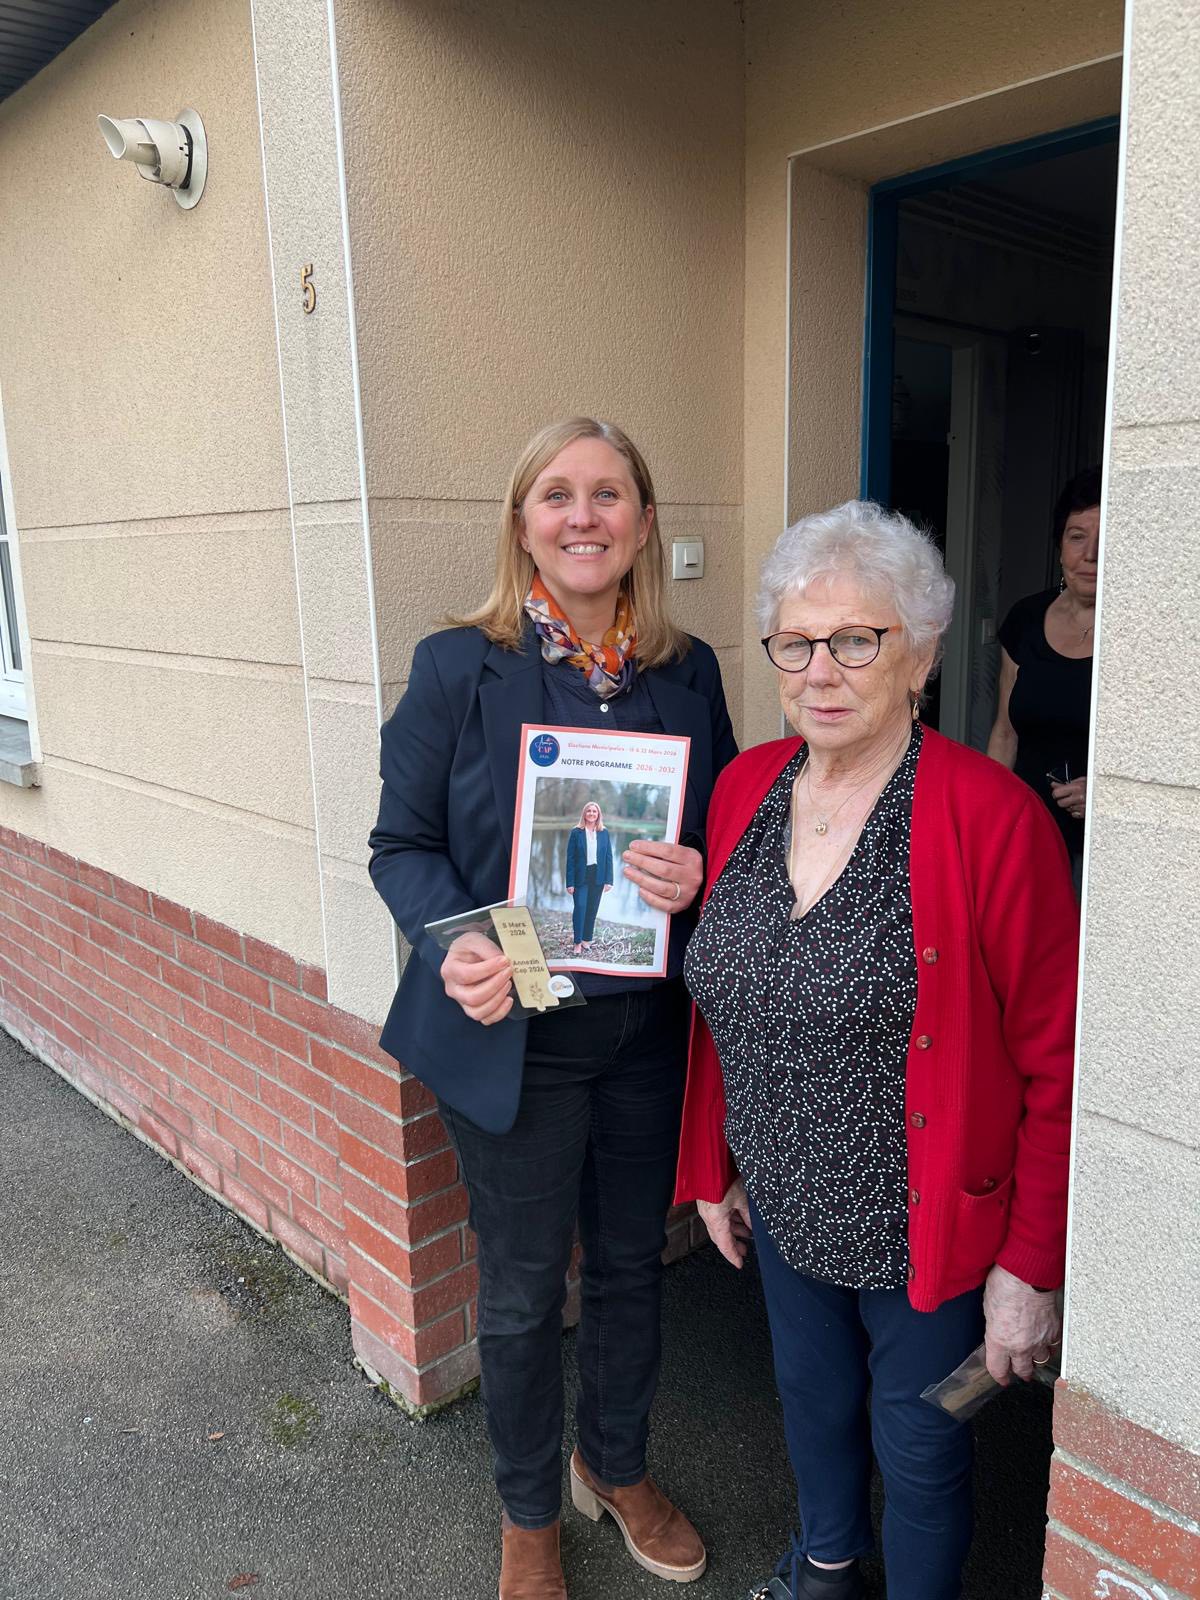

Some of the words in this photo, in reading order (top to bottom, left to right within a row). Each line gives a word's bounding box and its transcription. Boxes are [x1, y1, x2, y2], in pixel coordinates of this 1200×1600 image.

[301, 263, 316, 314] 5
[561, 758, 584, 766] NOTRE
[585, 760, 632, 770] PROGRAMME
[636, 764, 653, 772] 2026
[658, 765, 675, 774] 2032
